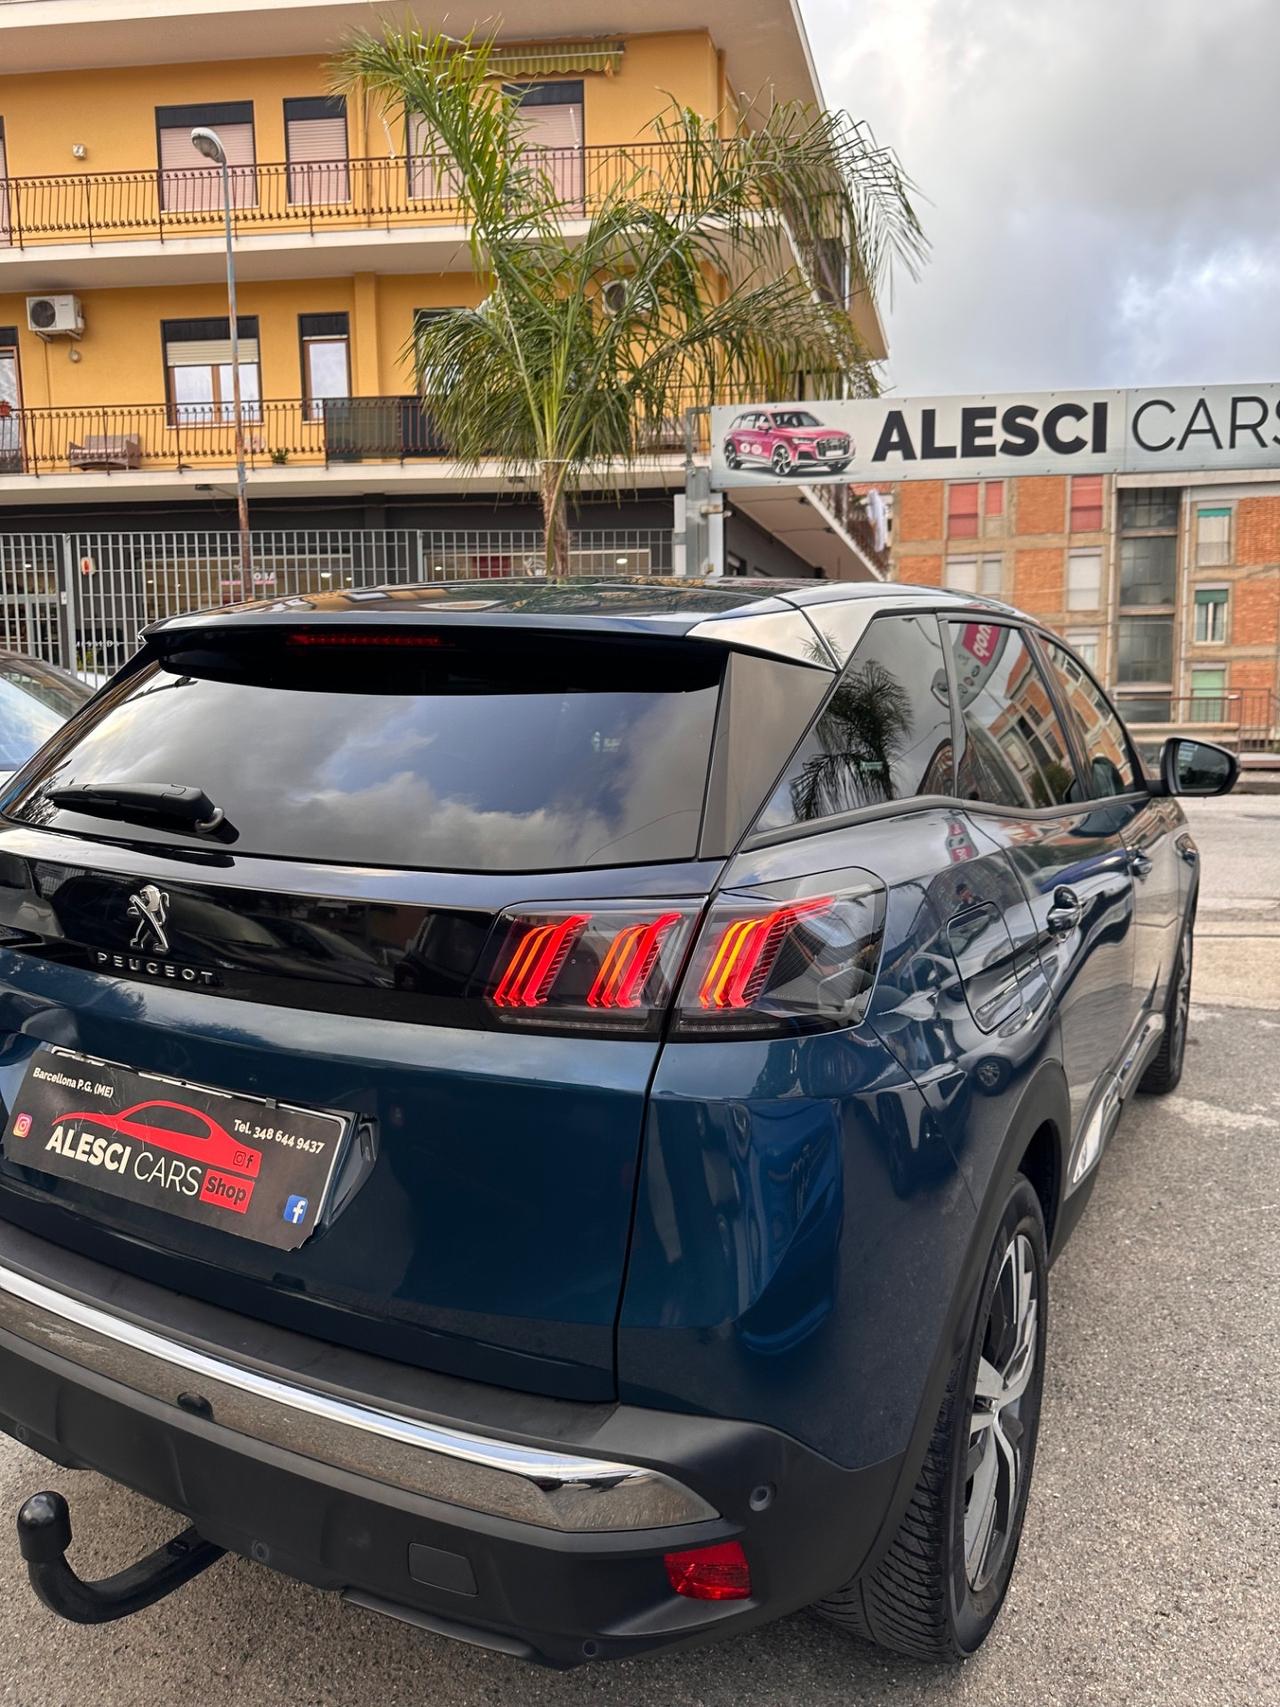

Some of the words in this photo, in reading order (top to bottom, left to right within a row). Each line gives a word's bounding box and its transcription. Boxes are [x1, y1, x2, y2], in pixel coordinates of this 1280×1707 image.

[871, 401, 1108, 463] ALESCI
[1132, 396, 1280, 452] CAR
[97, 952, 213, 984] PEUGEOT
[33, 1067, 76, 1089] Barcellona
[77, 1078, 93, 1094] P.G.
[94, 1082, 114, 1099] (ME)
[234, 1119, 252, 1135] Tel.
[253, 1125, 274, 1141] 348
[275, 1131, 296, 1147] 644
[297, 1136, 325, 1154] 9437
[45, 1126, 132, 1174] ALESCI
[133, 1150, 202, 1198] CARS
[205, 1175, 247, 1204] Shop
